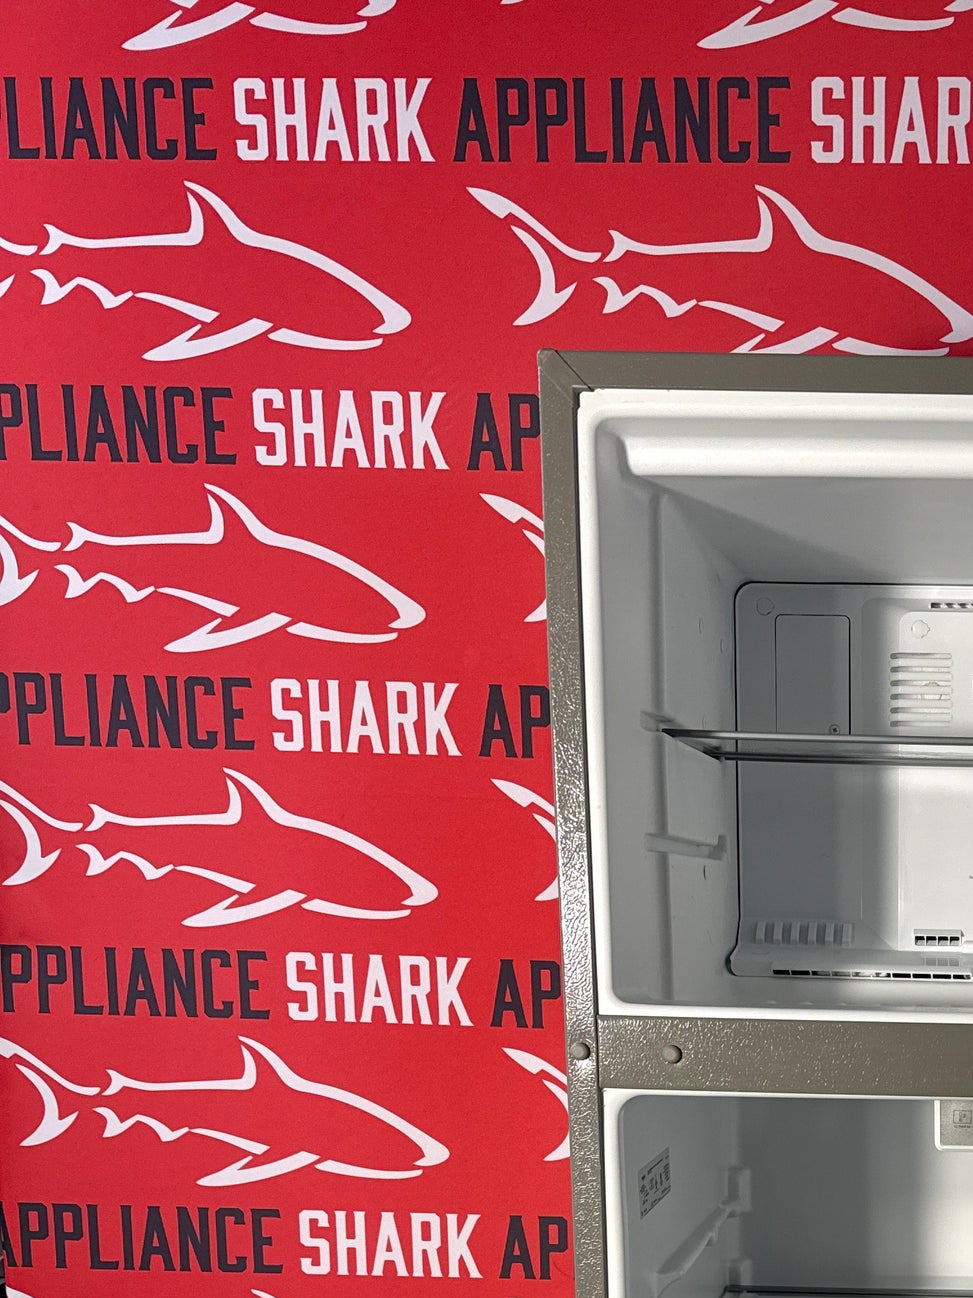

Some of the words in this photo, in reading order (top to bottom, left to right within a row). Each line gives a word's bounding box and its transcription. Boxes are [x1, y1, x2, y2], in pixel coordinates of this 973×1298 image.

[233, 77, 435, 161] SHARK
[454, 76, 791, 163] APPLIANCE
[0, 384, 236, 464] PLIANCE
[252, 388, 450, 469] SHARK
[467, 393, 540, 471] AP
[271, 678, 462, 756] SHARK
[480, 684, 551, 758] AP
[0, 944, 269, 1020] PPLIANCE
[286, 952, 474, 1026] SHARK
[491, 959, 561, 1029] AP
[299, 1209, 482, 1279] SHARK
[499, 1215, 568, 1280] AP
